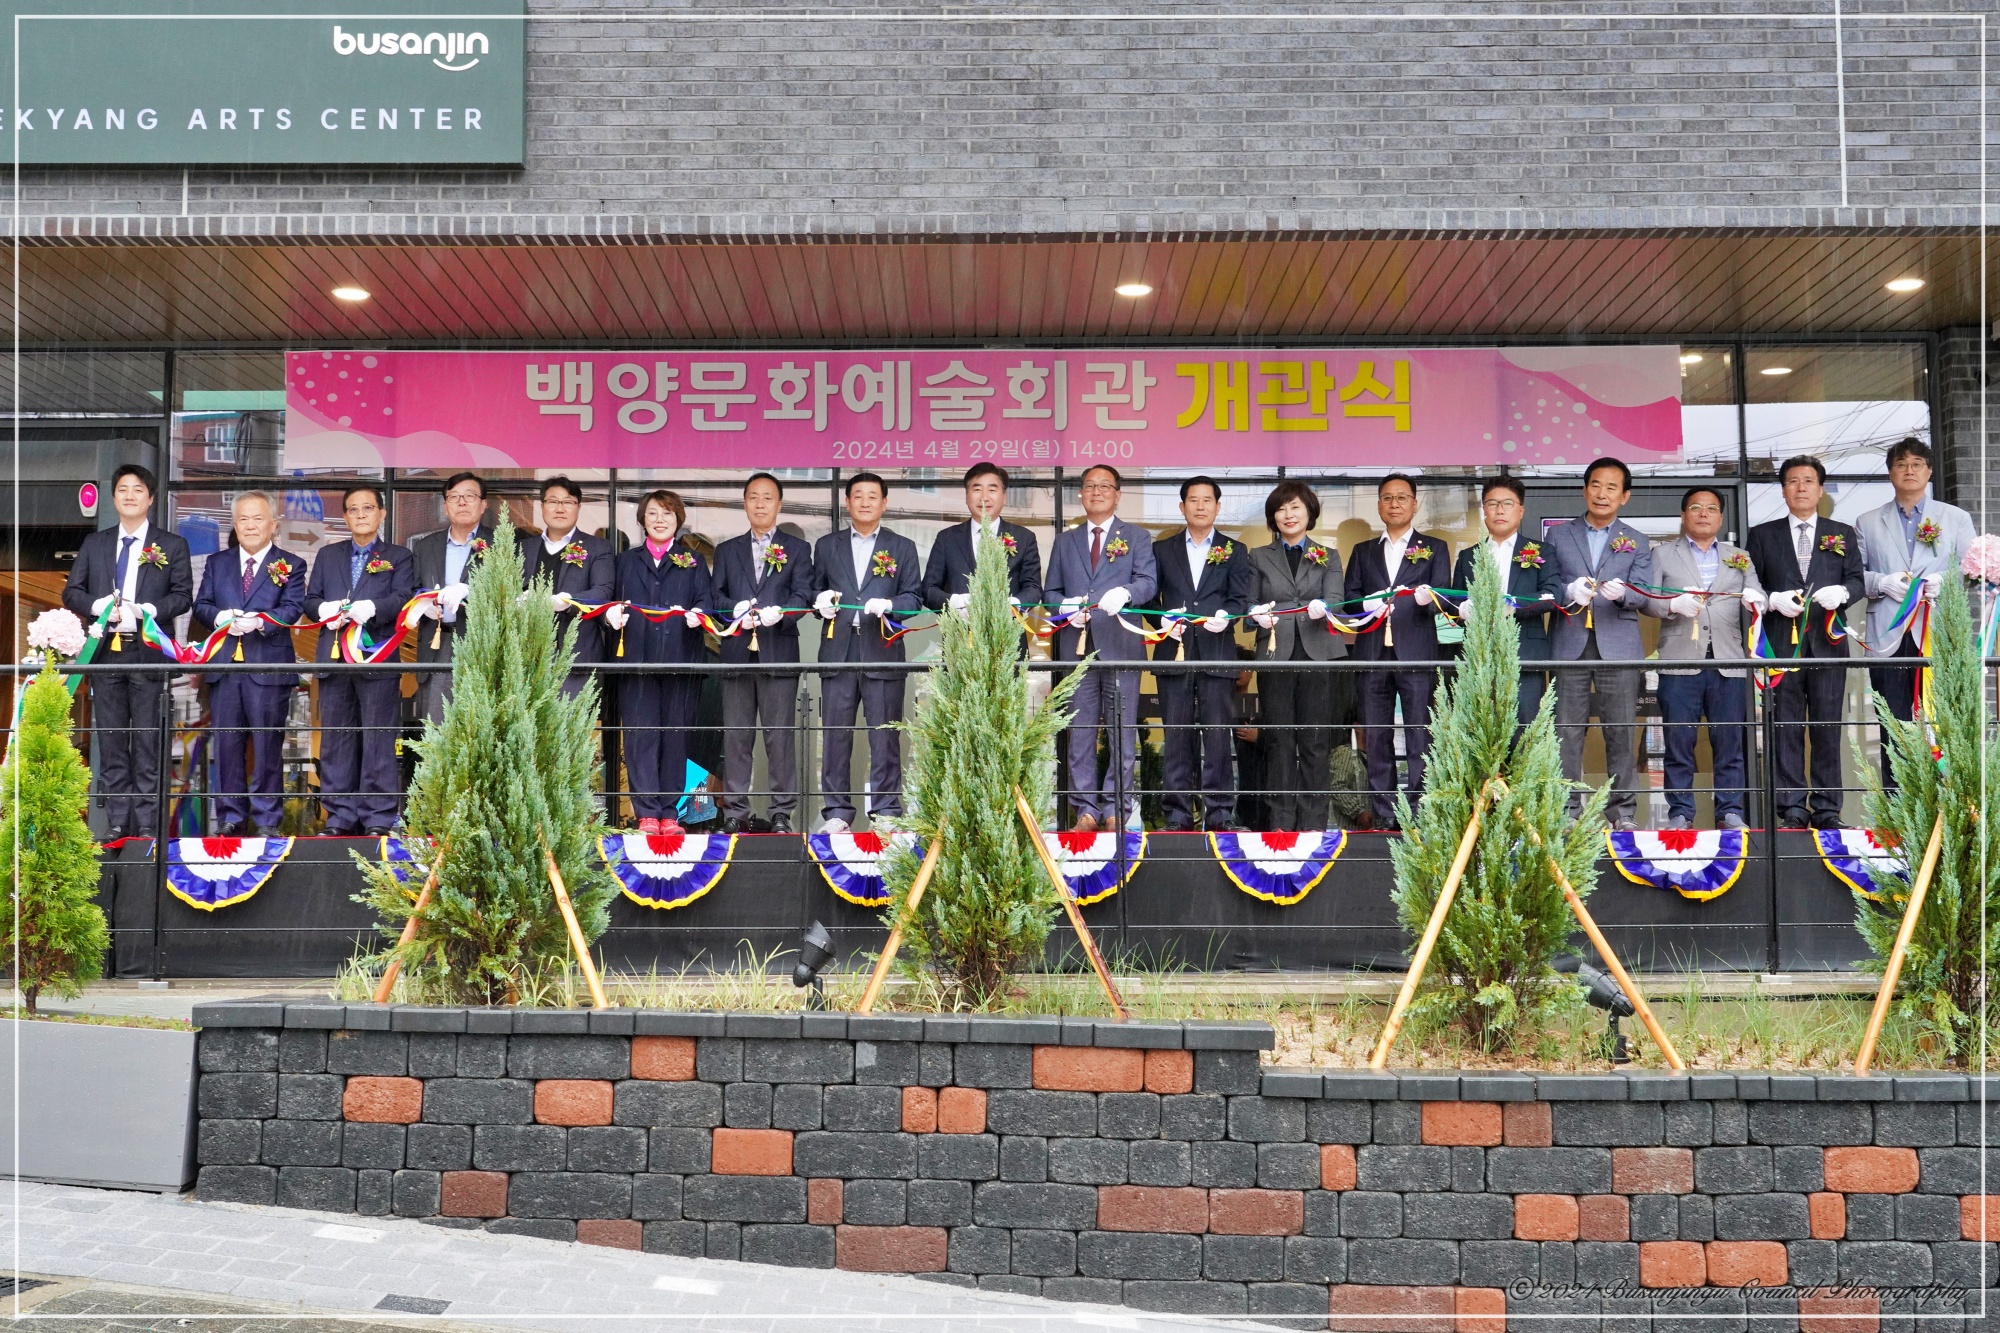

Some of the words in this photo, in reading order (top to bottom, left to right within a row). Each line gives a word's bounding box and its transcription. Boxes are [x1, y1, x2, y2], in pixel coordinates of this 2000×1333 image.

[333, 25, 489, 63] busanjin
[0, 108, 158, 130] KYANG
[187, 108, 292, 130] ARTS
[320, 108, 482, 130] CENTER
[525, 359, 1157, 434] 백양문화예술회관
[1175, 359, 1412, 432] 개관식
[832, 440, 914, 460] 2024년
[923, 439, 960, 459] 4월
[969, 439, 1061, 459] 29일(월)
[1069, 439, 1135, 460] 14:00
